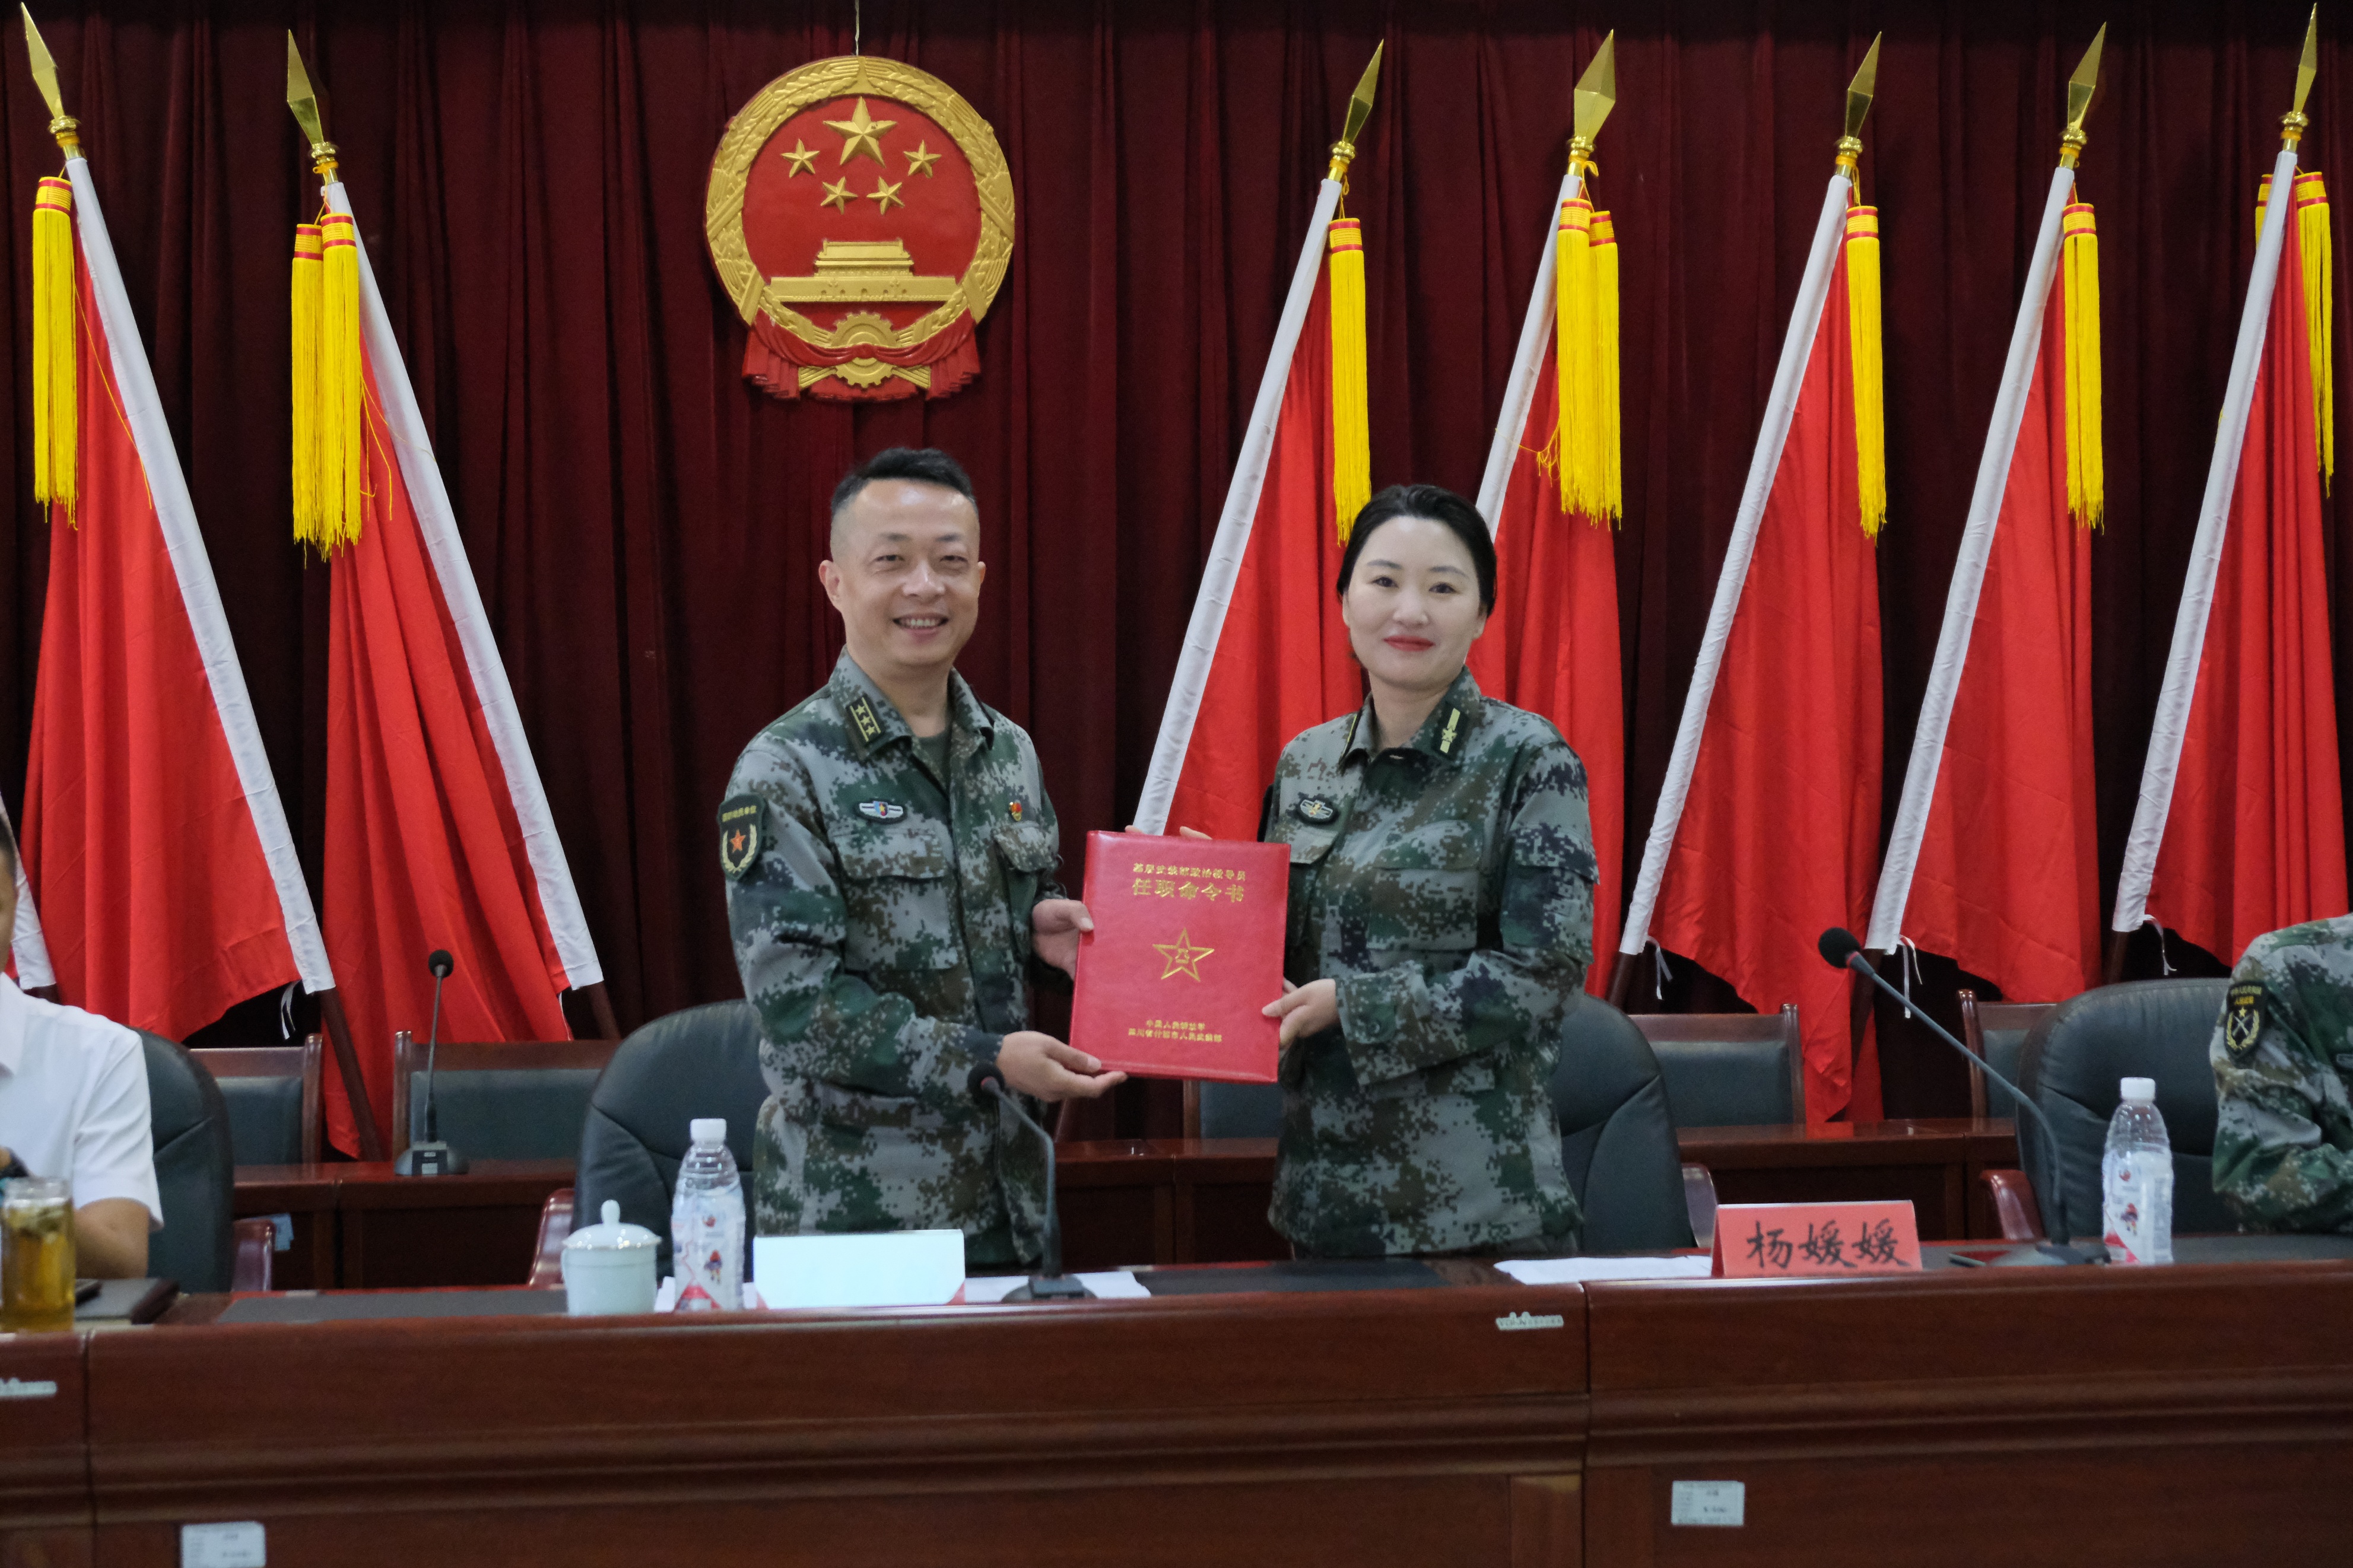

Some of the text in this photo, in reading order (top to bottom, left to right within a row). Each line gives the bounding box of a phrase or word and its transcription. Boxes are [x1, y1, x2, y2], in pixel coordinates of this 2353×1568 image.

[1132, 877, 1244, 903] 任职命令书
[1747, 1218, 1910, 1268] 杨媛媛
